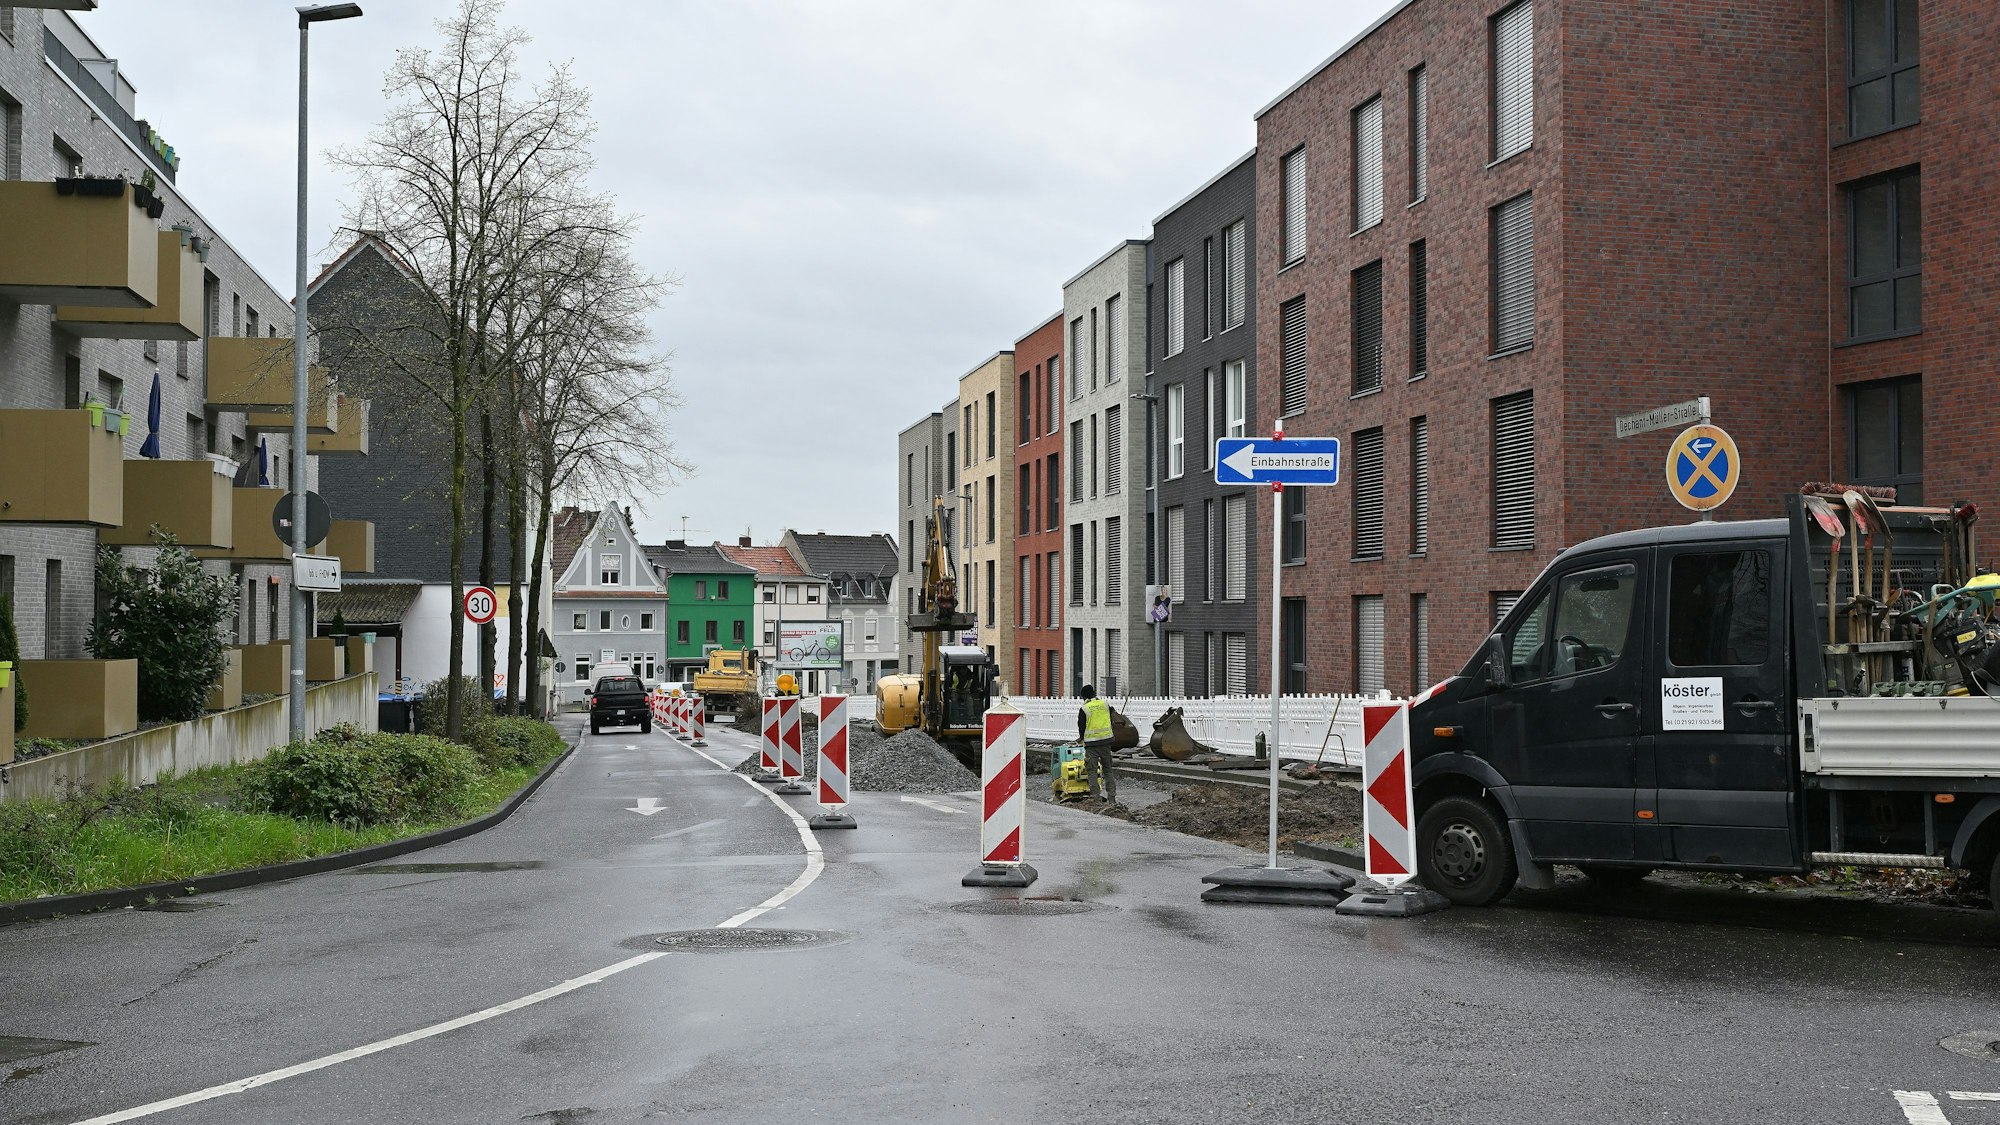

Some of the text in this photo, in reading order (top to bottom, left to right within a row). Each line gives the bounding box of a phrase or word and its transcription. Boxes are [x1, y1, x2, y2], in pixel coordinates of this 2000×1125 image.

[1251, 456, 1330, 467] Einbahnstraße
[471, 597, 490, 613] 30
[1664, 684, 1710, 697] köster
